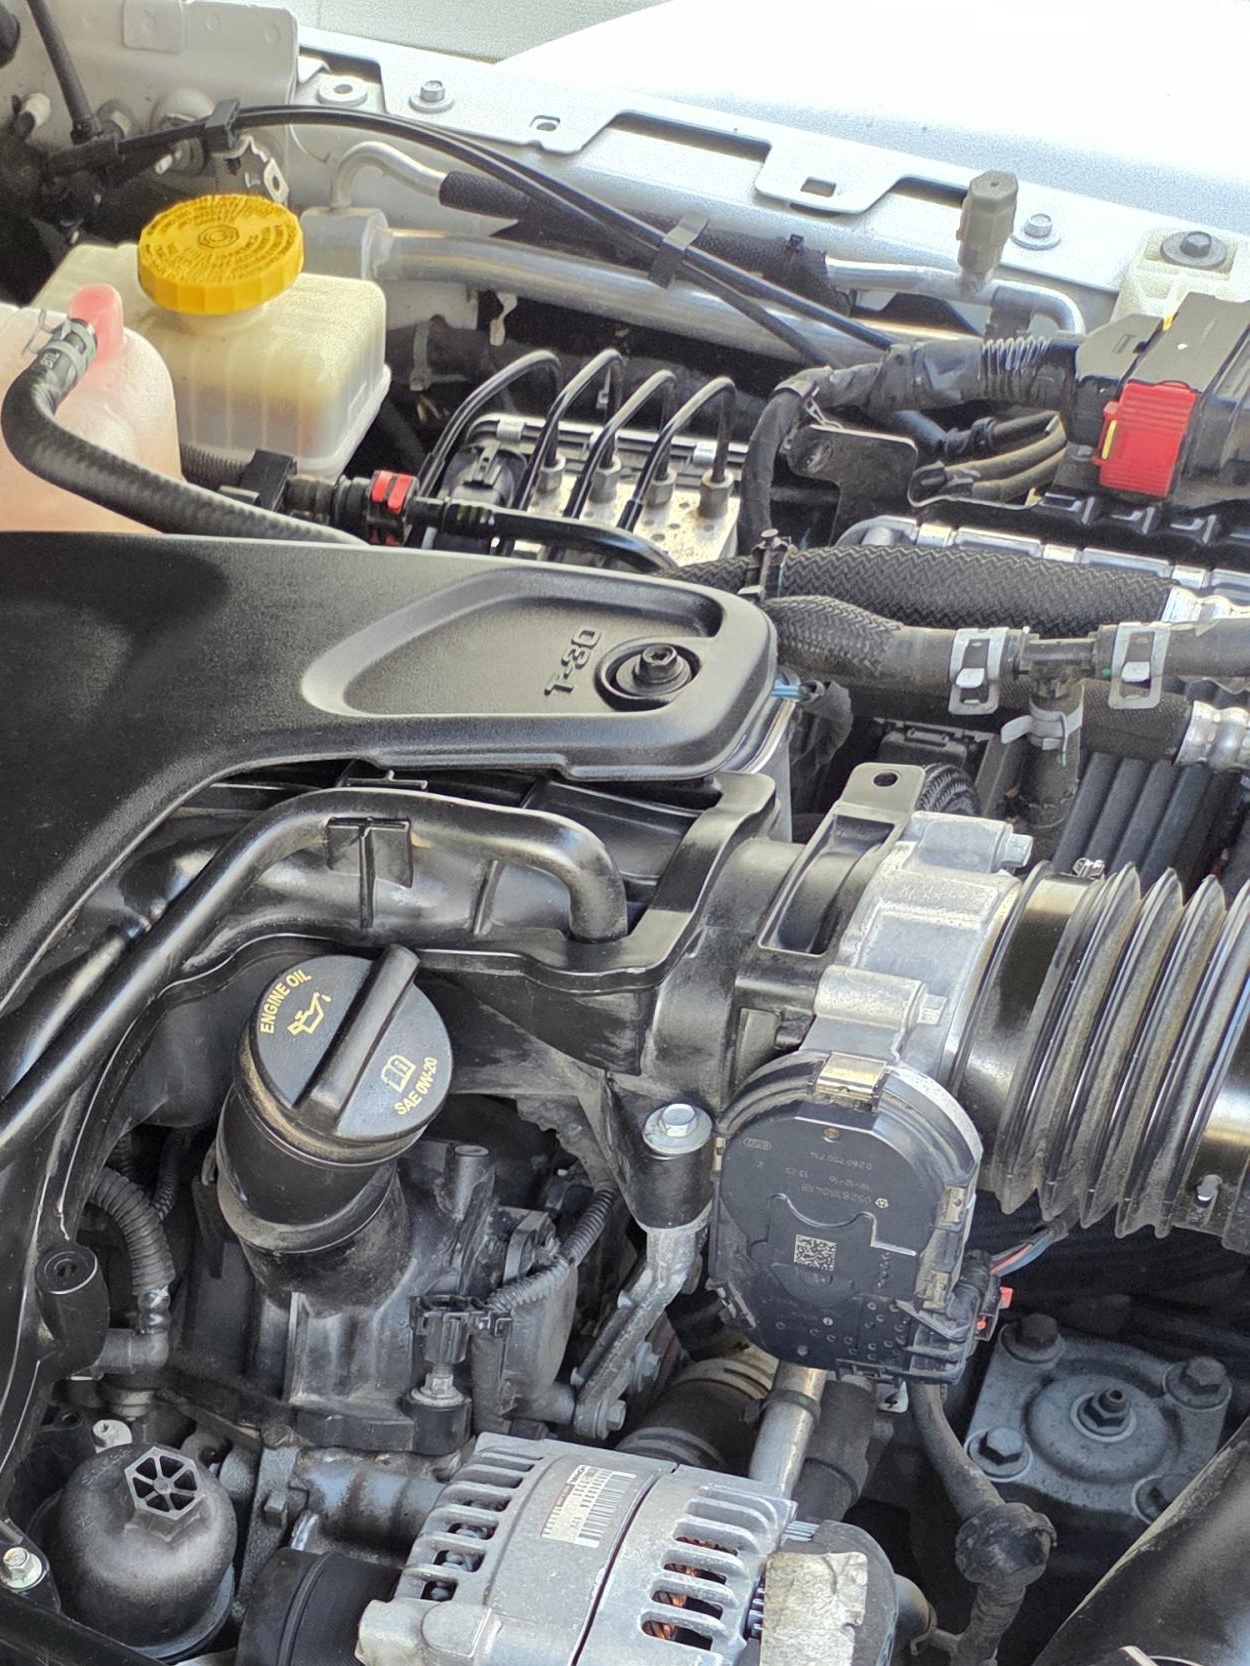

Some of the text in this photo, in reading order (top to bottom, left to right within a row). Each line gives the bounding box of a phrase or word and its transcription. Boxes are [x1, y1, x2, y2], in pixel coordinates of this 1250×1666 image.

[544, 629, 603, 697] T-30
[260, 969, 312, 1034] ENGINE OIL
[395, 1056, 438, 1116] SAE 0W-20
